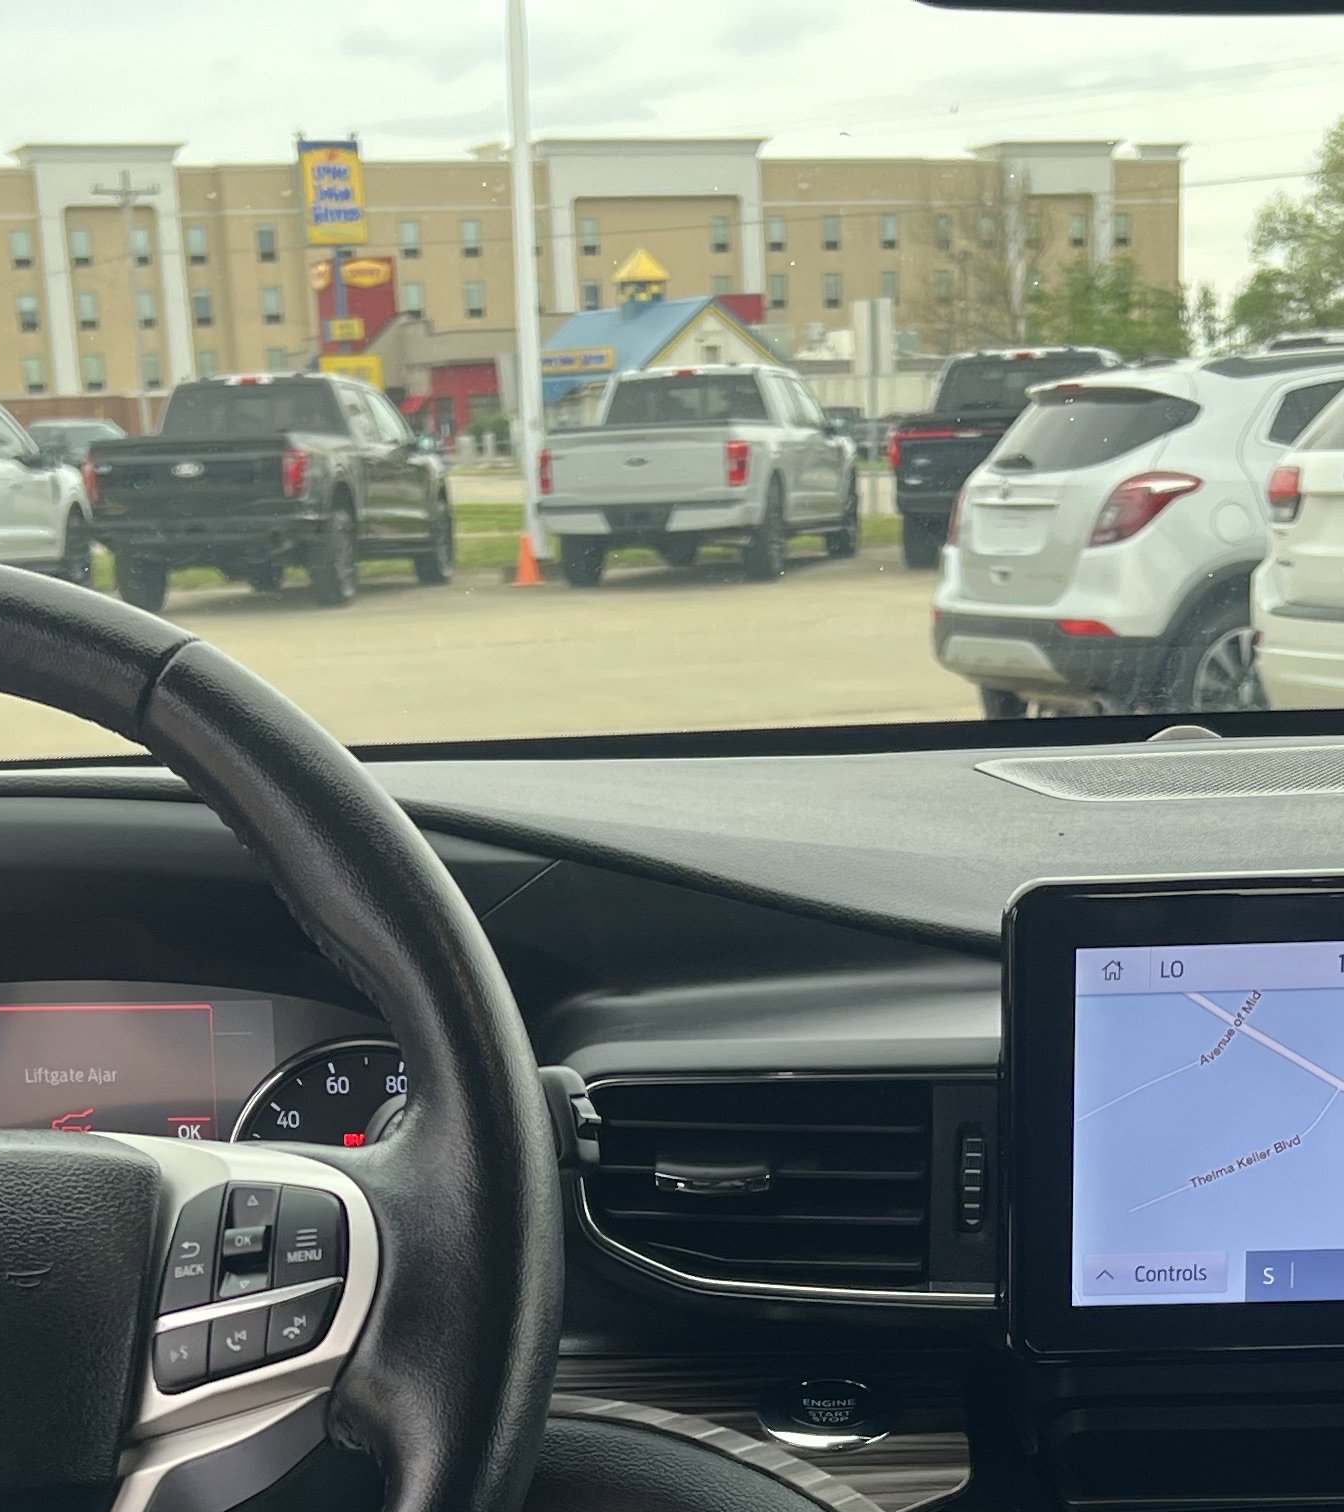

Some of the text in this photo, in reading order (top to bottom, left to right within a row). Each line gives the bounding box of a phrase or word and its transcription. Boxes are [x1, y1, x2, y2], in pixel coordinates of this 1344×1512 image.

[1160, 960, 1185, 979] LO
[1199, 989, 1262, 1067] Avenue of Mid
[24, 1067, 118, 1085] Liftgate Ajar
[325, 1076, 350, 1094] 60
[385, 1075, 408, 1094] 80
[276, 1110, 300, 1129] 40
[177, 1124, 202, 1140] OK
[1189, 1133, 1302, 1189] Thelma Keller Blvd
[234, 1235, 252, 1247] OK
[286, 1248, 323, 1264] MENU
[174, 1263, 205, 1279] BACK
[1134, 1263, 1208, 1283] Controls
[1263, 1268, 1274, 1285] S
[802, 1398, 856, 1408] ENGINE
[811, 1415, 849, 1423] STOP
